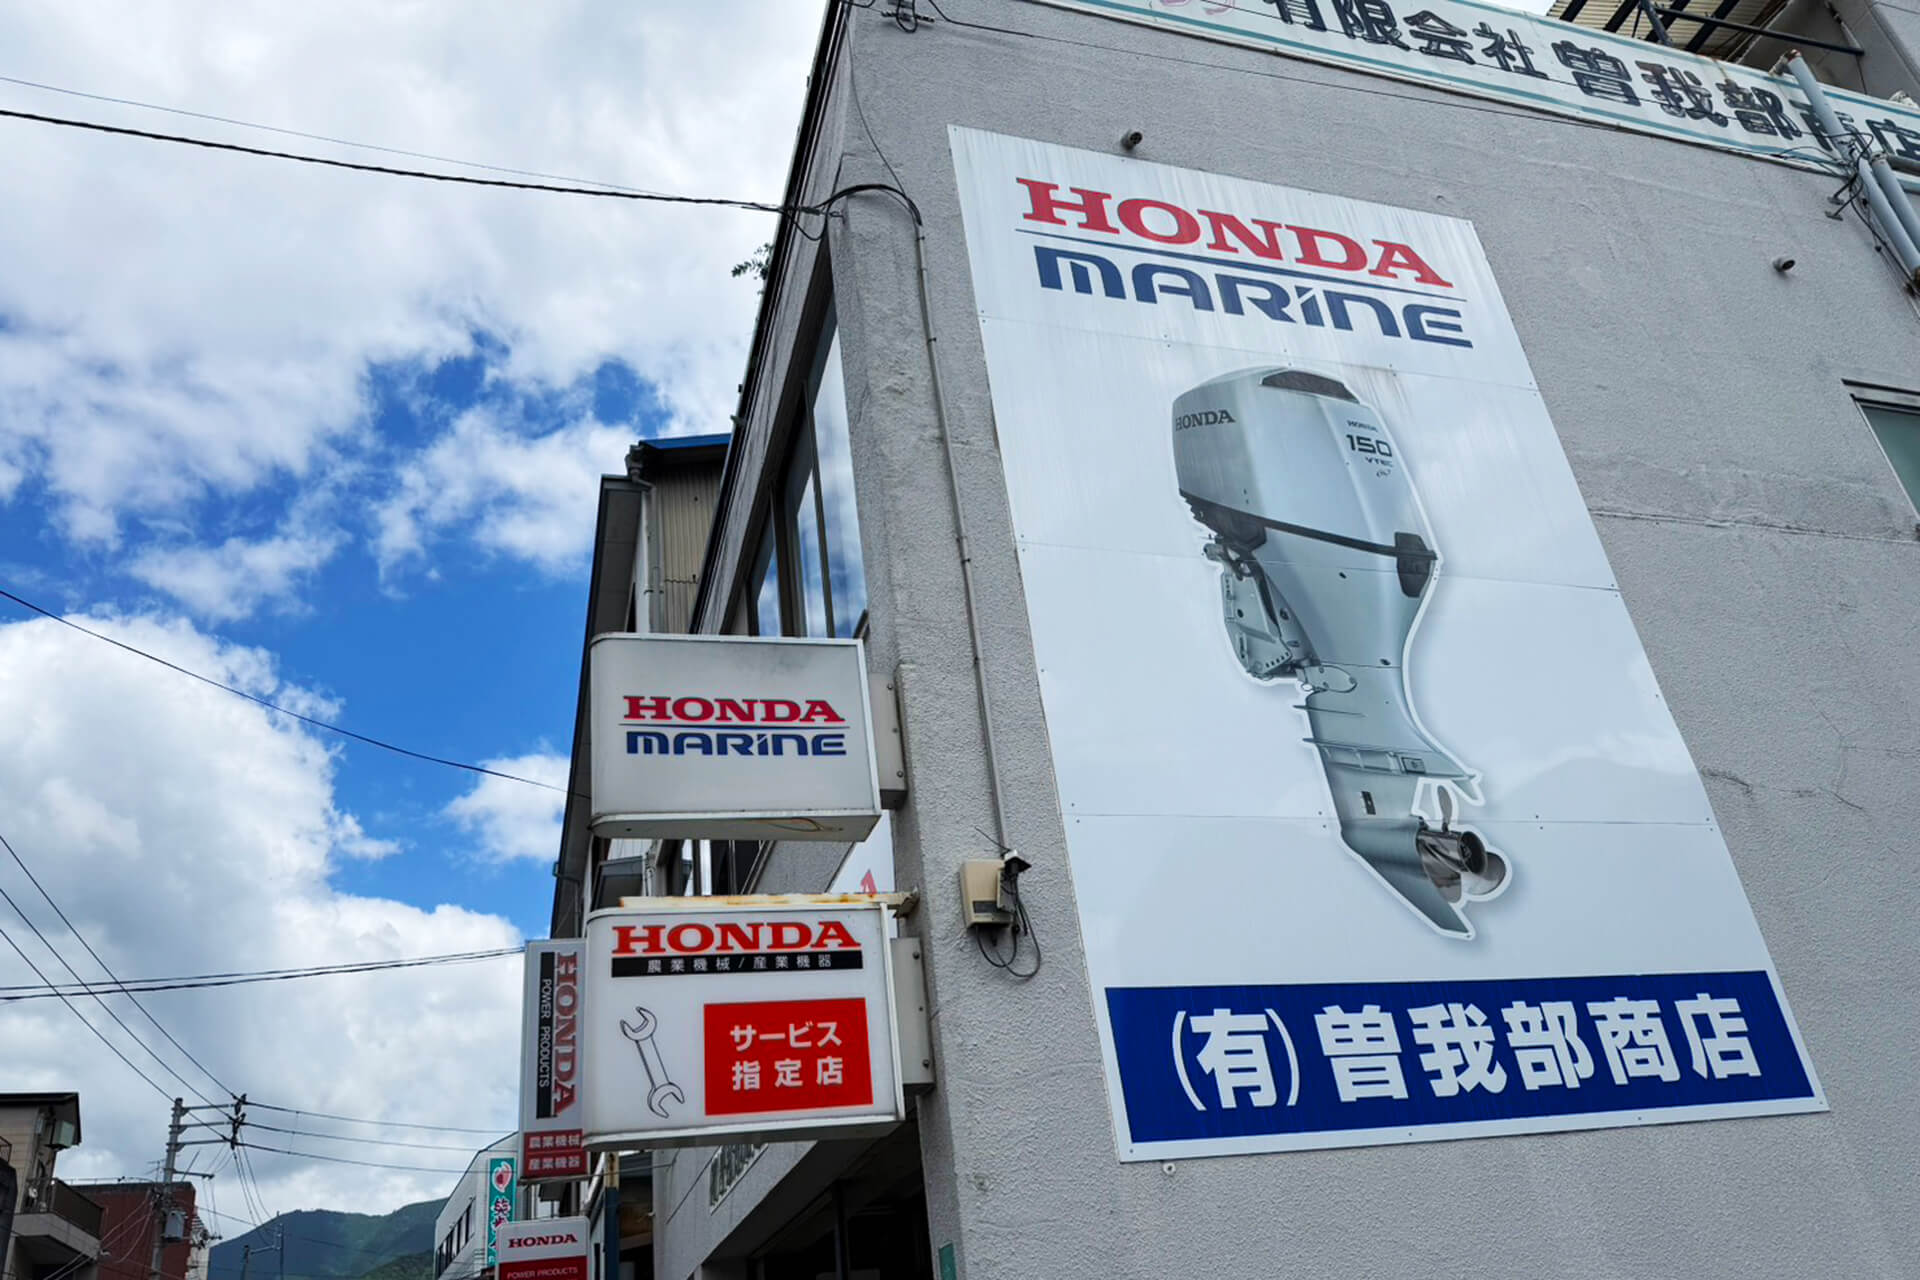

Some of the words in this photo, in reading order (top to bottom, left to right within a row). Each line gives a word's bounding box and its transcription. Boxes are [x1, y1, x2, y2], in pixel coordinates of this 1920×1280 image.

[1016, 177, 1454, 288] HONDA
[1034, 245, 1474, 348] MARINE
[1175, 408, 1236, 432] HONDA
[1346, 434, 1392, 456] 150
[623, 696, 845, 722] HONDA
[626, 731, 847, 755] MARINE
[612, 921, 861, 954] HONDA
[540, 978, 552, 1018] POWER
[553, 951, 578, 1117] HONDA
[730, 1021, 842, 1052] サービス
[539, 1025, 551, 1088] PRODUCTS
[732, 1055, 843, 1091] 指定店
[508, 1234, 578, 1248] HONDA
[507, 1270, 535, 1279] POWER
[537, 1266, 578, 1276] PRODUCTS
